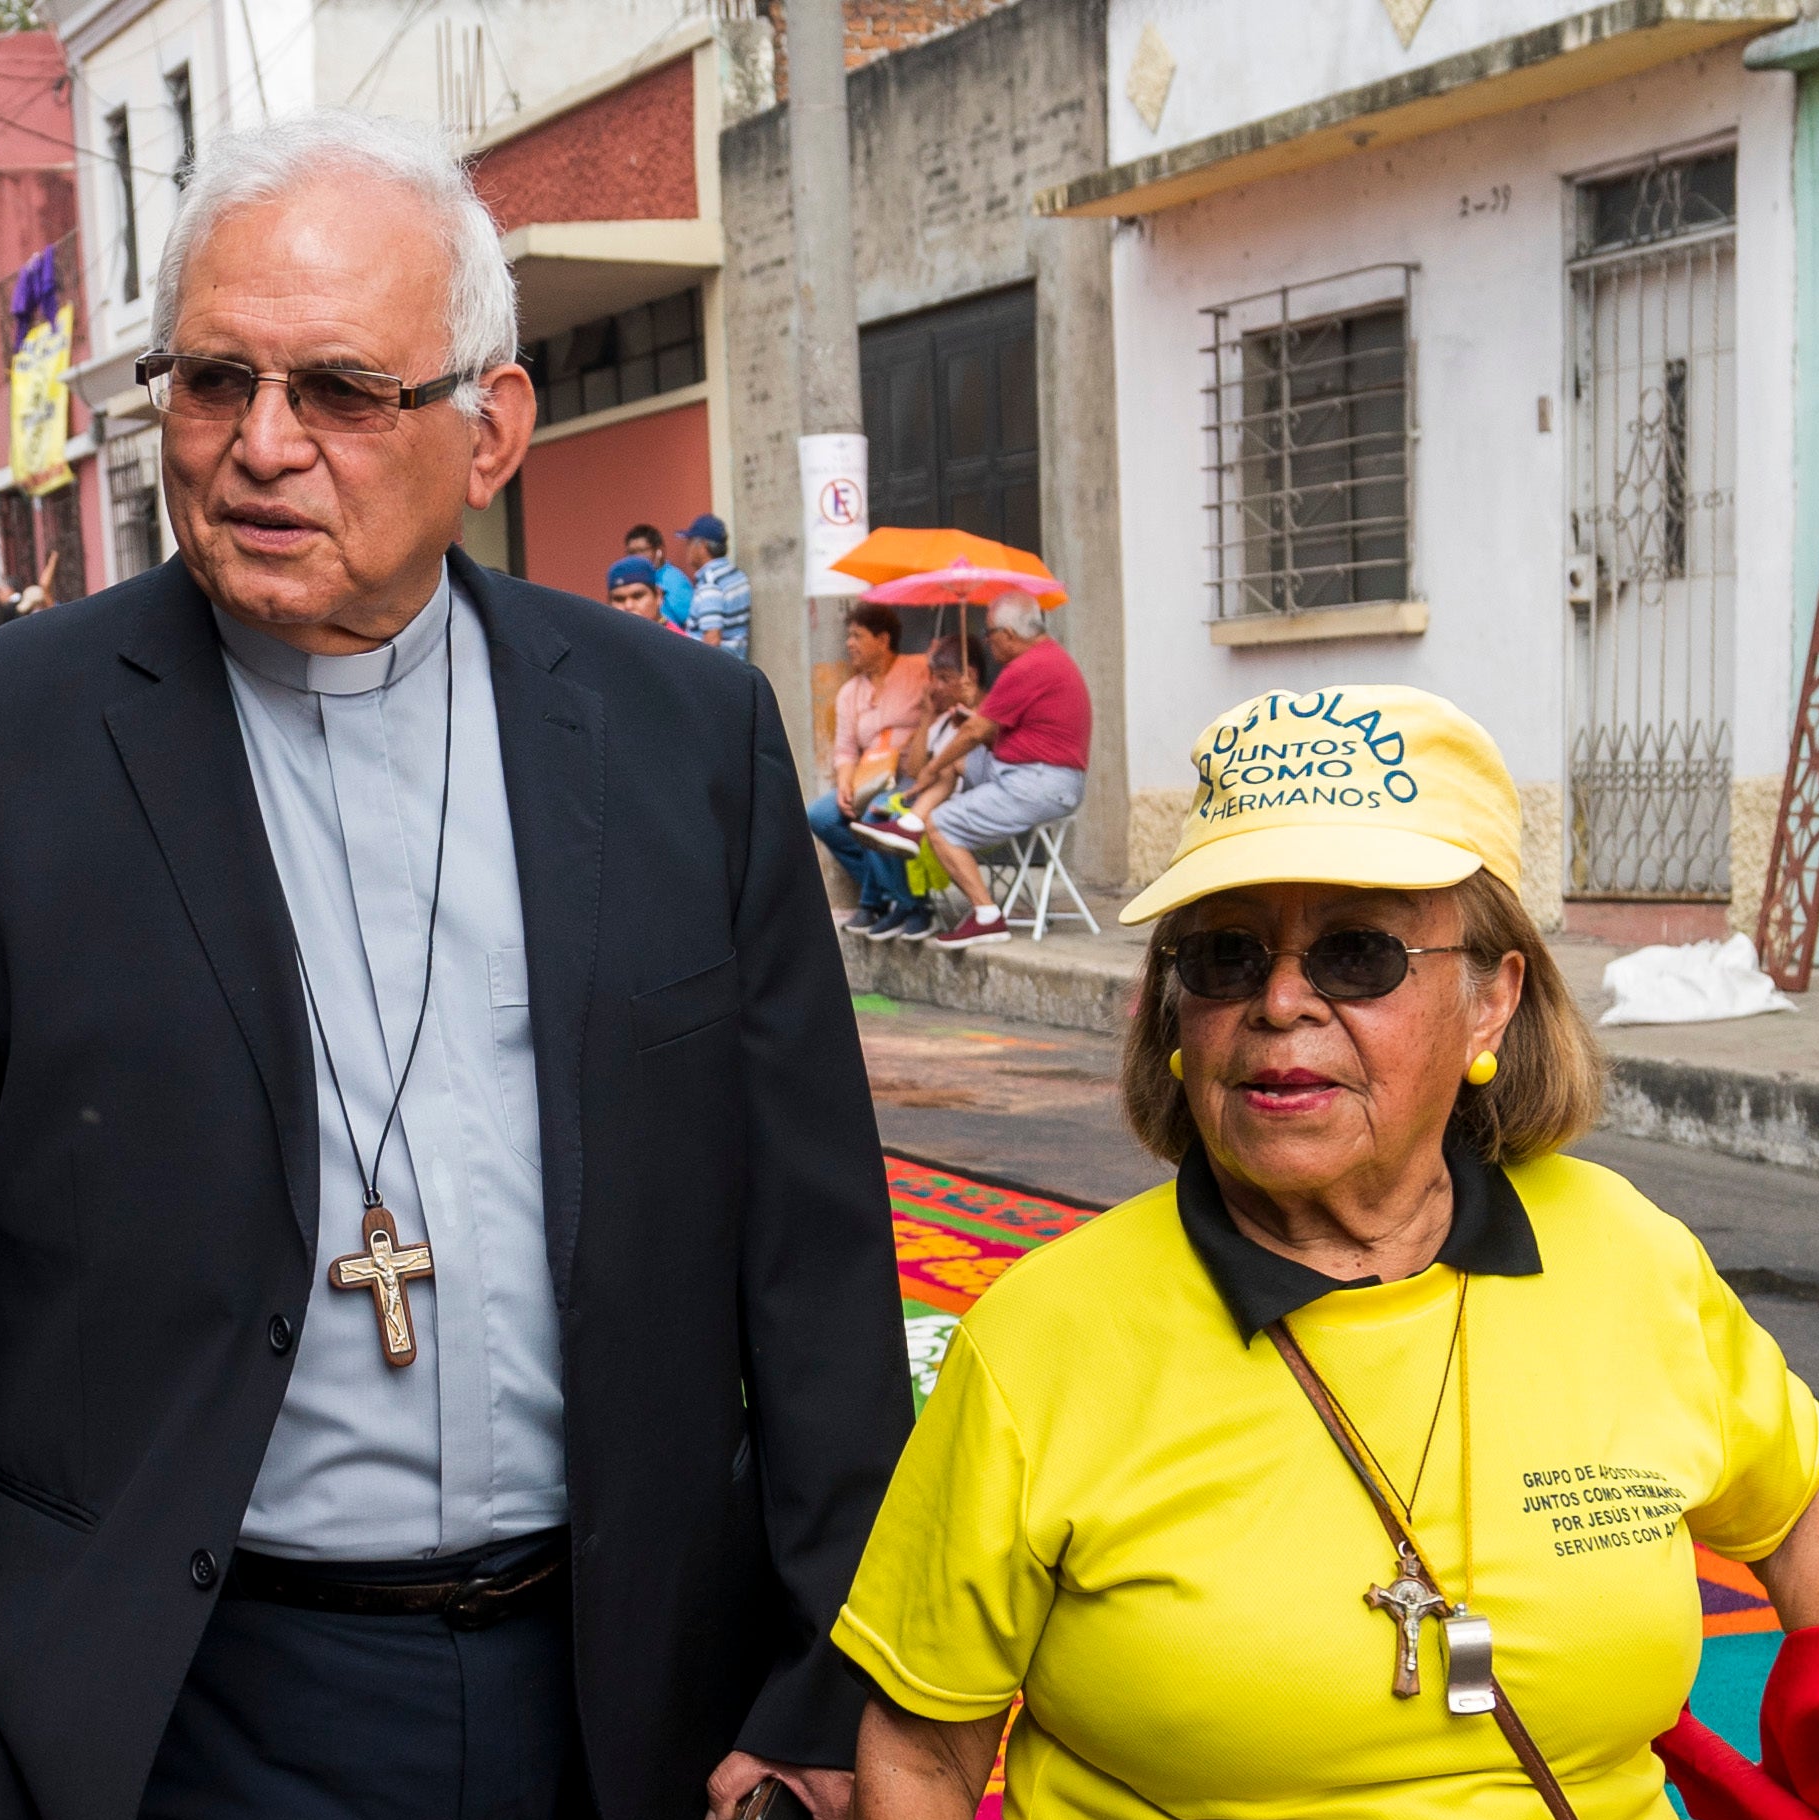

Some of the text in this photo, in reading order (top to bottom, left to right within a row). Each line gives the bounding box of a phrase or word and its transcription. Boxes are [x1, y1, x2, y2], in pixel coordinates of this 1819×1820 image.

[1223, 739, 1357, 770] JUNTOS
[1219, 760, 1353, 790] COMO
[1210, 786, 1381, 824] HERMANOS
[1523, 1469, 1572, 1488] GRUPO
[1575, 1465, 1596, 1481] DE
[1523, 1492, 1580, 1513] JUNTOS
[1583, 1487, 1622, 1503] COMO
[1552, 1515, 1584, 1533] POR
[1588, 1505, 1631, 1528] JESÚS
[1631, 1506, 1641, 1521] Y
[1554, 1531, 1631, 1557] SERVIMOS
[1632, 1526, 1662, 1544] CON
